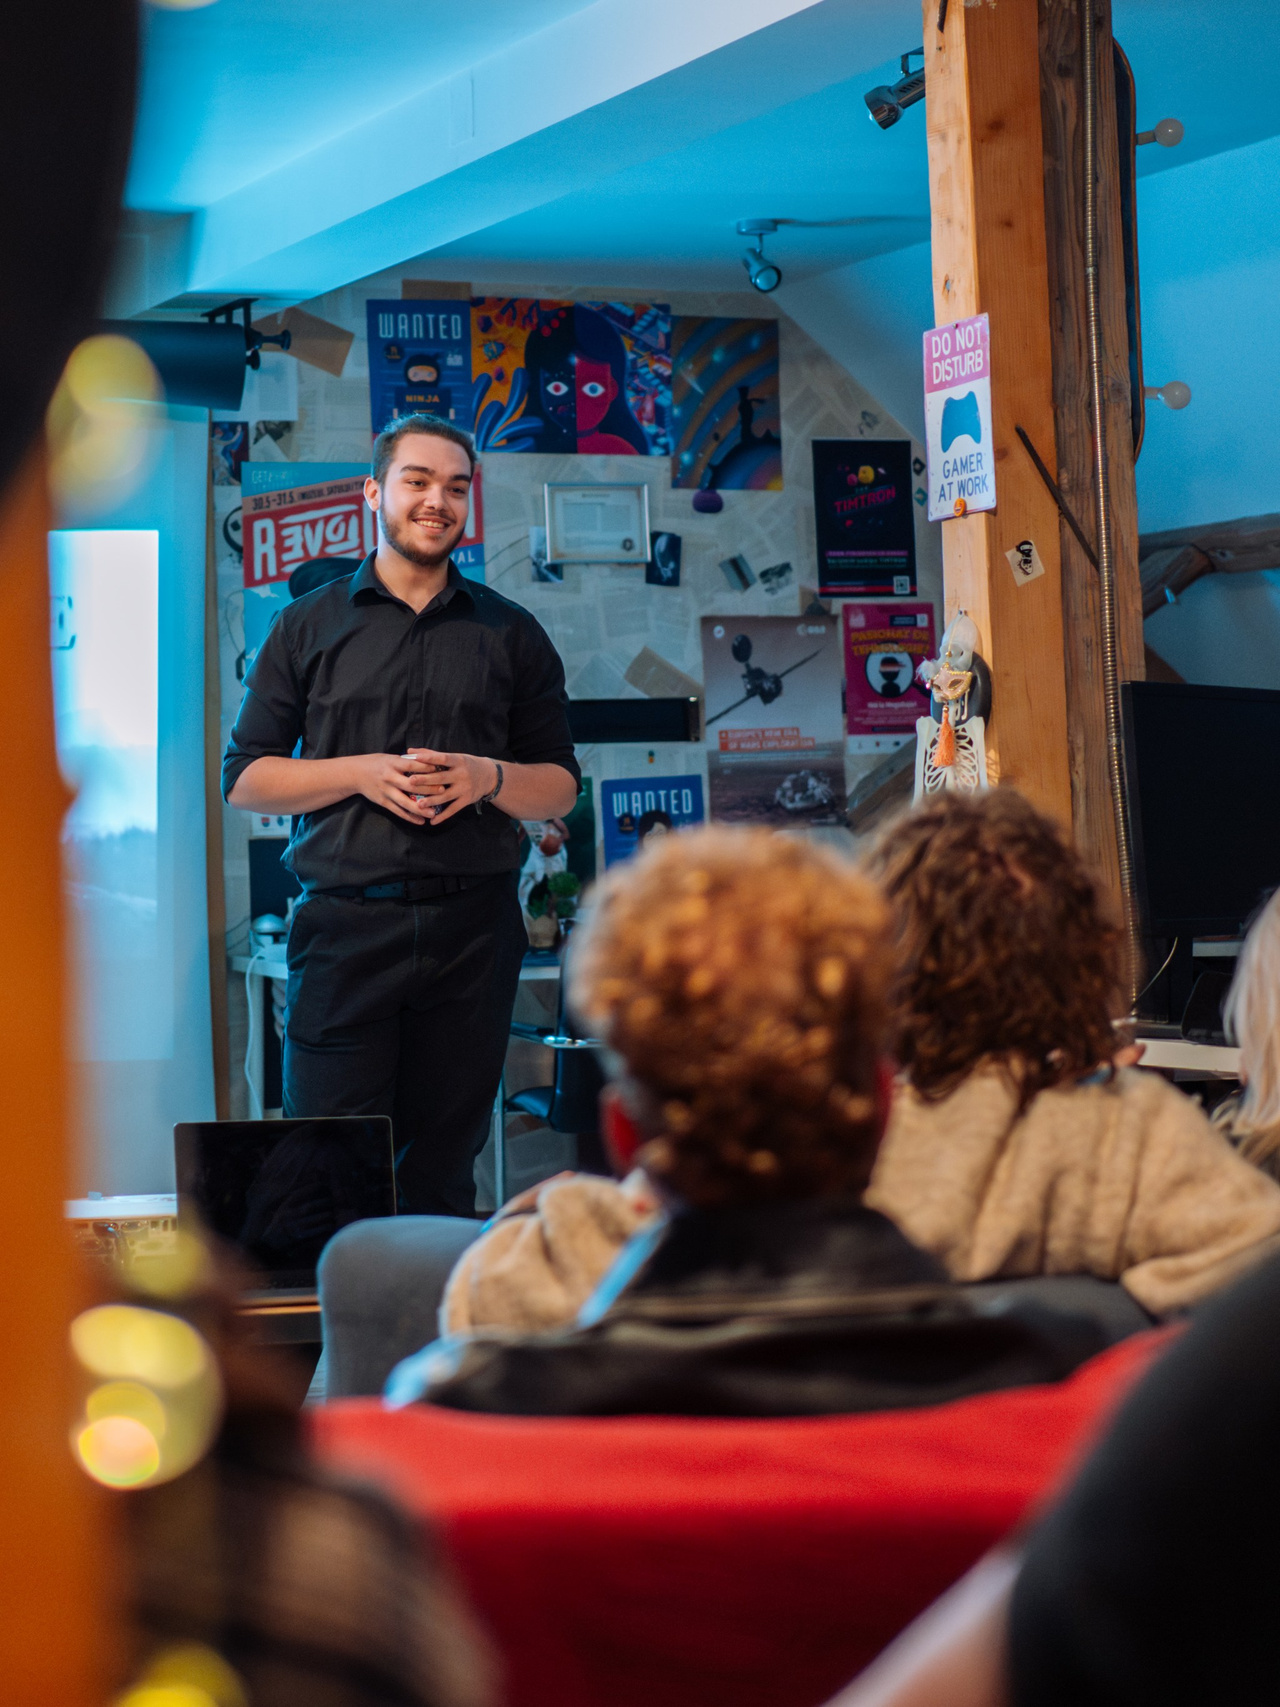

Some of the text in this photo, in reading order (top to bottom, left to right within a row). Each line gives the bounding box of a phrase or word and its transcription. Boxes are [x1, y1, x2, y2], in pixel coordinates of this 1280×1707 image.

[378, 313, 462, 339] WANTED
[931, 322, 982, 359] DO NOT
[932, 349, 984, 384] DISTURB
[405, 394, 440, 403] NINJA
[942, 452, 984, 479] GAMER
[834, 486, 896, 513] TIMTRON
[938, 473, 989, 503] AT WORK
[612, 788, 692, 818] WANTED
